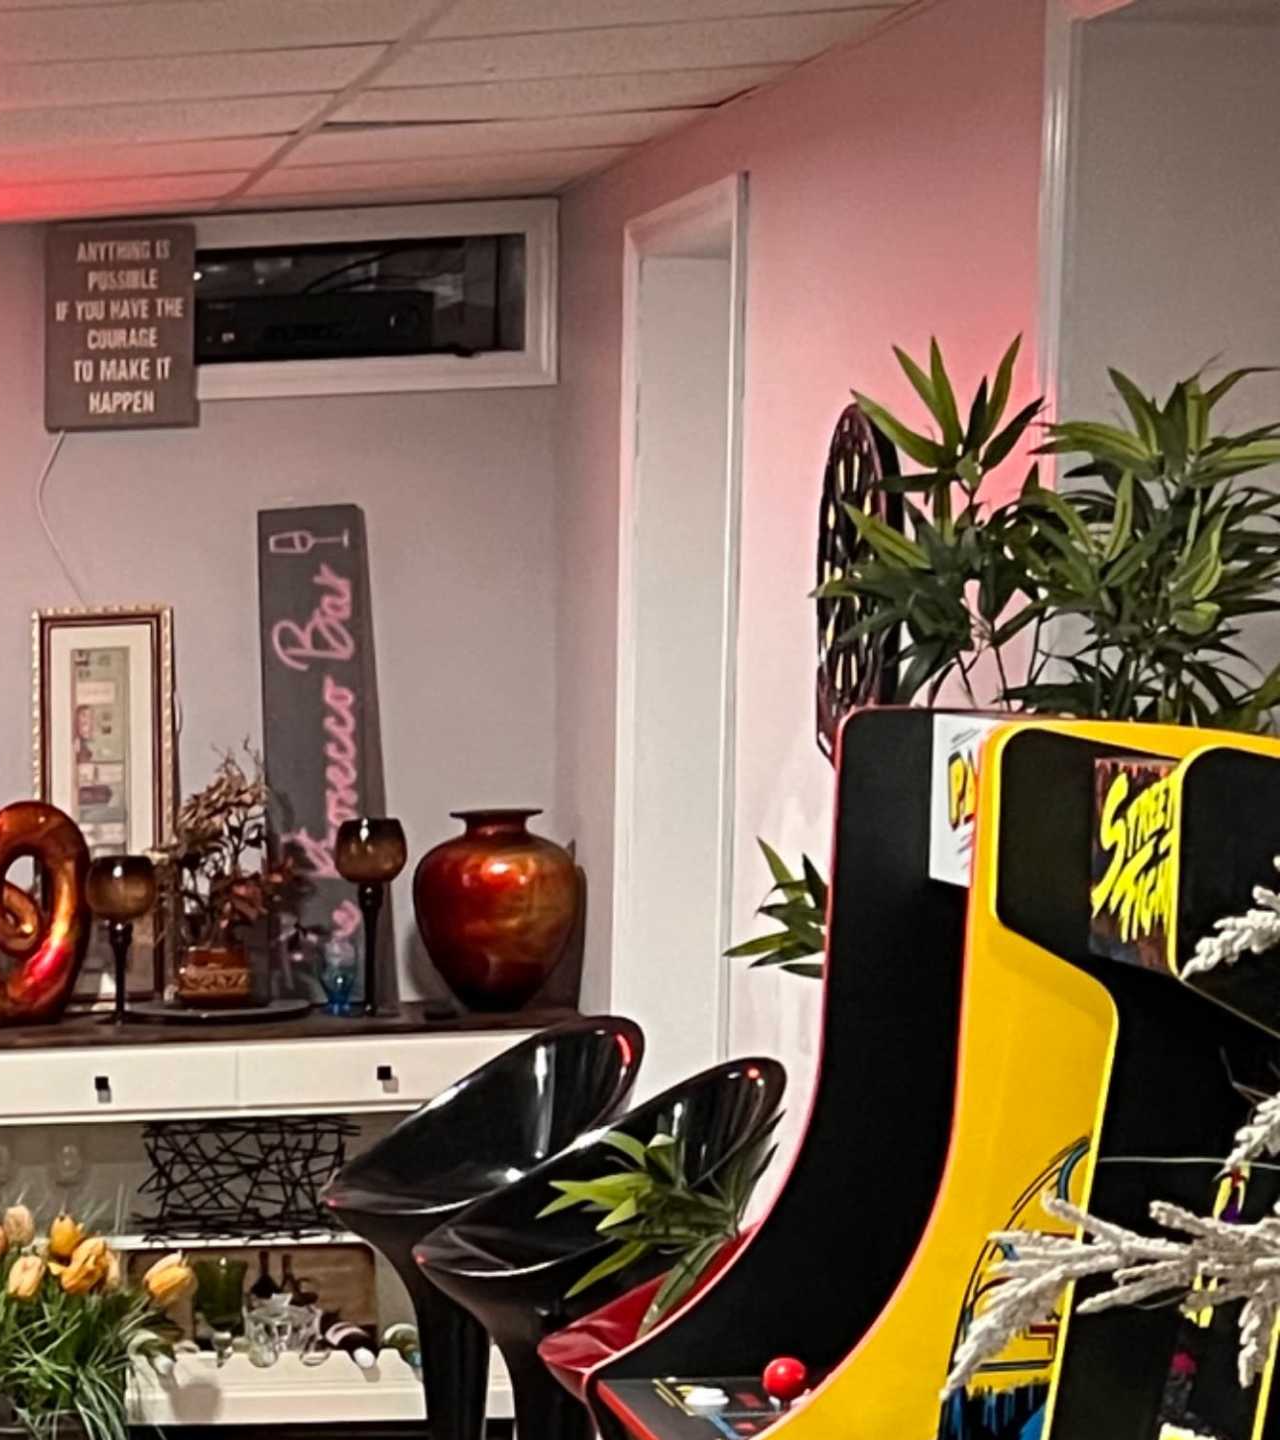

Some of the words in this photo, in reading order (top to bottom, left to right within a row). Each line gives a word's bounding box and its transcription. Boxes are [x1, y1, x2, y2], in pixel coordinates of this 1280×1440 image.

[76, 241, 151, 262] ANYTHING
[156, 240, 170, 259] IS
[88, 269, 159, 291] POSSIBLE
[56, 301, 69, 321] IF
[75, 300, 105, 320] YOU
[110, 298, 149, 320] HAVE
[156, 298, 183, 317] THE
[87, 328, 158, 349] COURAGE
[74, 360, 93, 382] TO
[100, 358, 151, 381] MAKE
[156, 357, 171, 380] IT
[89, 391, 155, 414] HAPPEN
[272, 564, 354, 671] Bar
